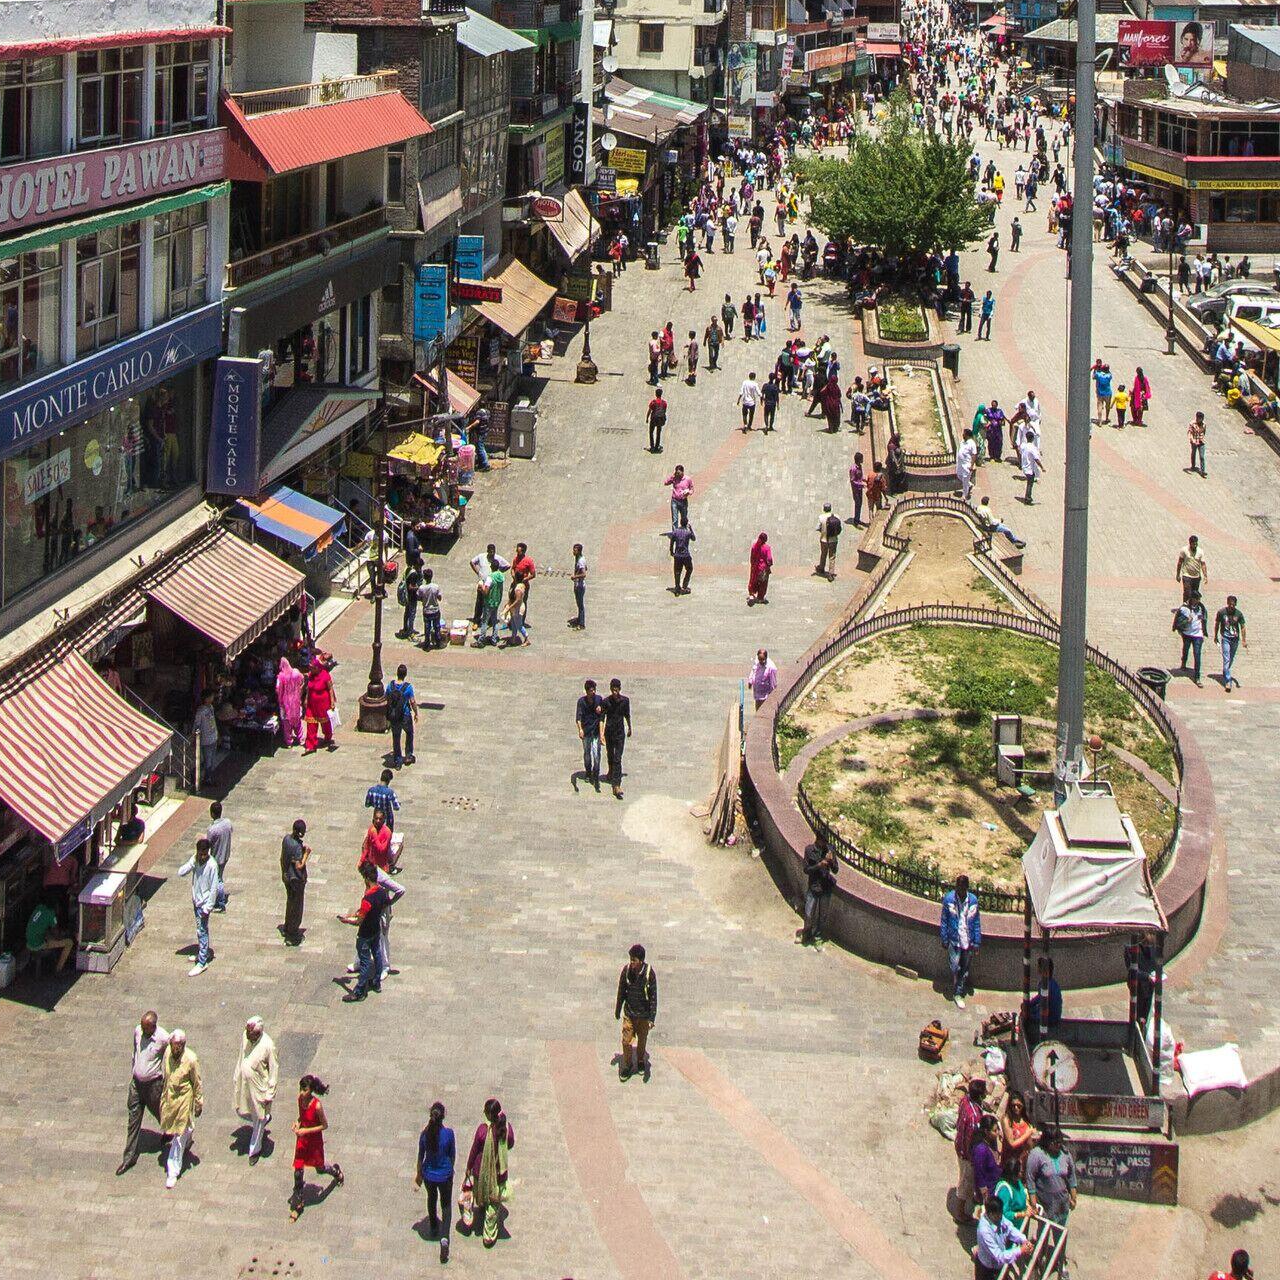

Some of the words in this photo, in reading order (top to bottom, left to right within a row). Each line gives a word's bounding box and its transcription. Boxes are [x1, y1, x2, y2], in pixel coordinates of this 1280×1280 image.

[100, 140, 200, 199] PAWAN
[573, 115, 586, 172] SONY
[12, 380, 88, 440] MONTE
[93, 350, 153, 399] CARLO
[226, 383, 239, 434] MONTE
[225, 436, 238, 487] CARLO
[1127, 1157, 1151, 1167] PASS
